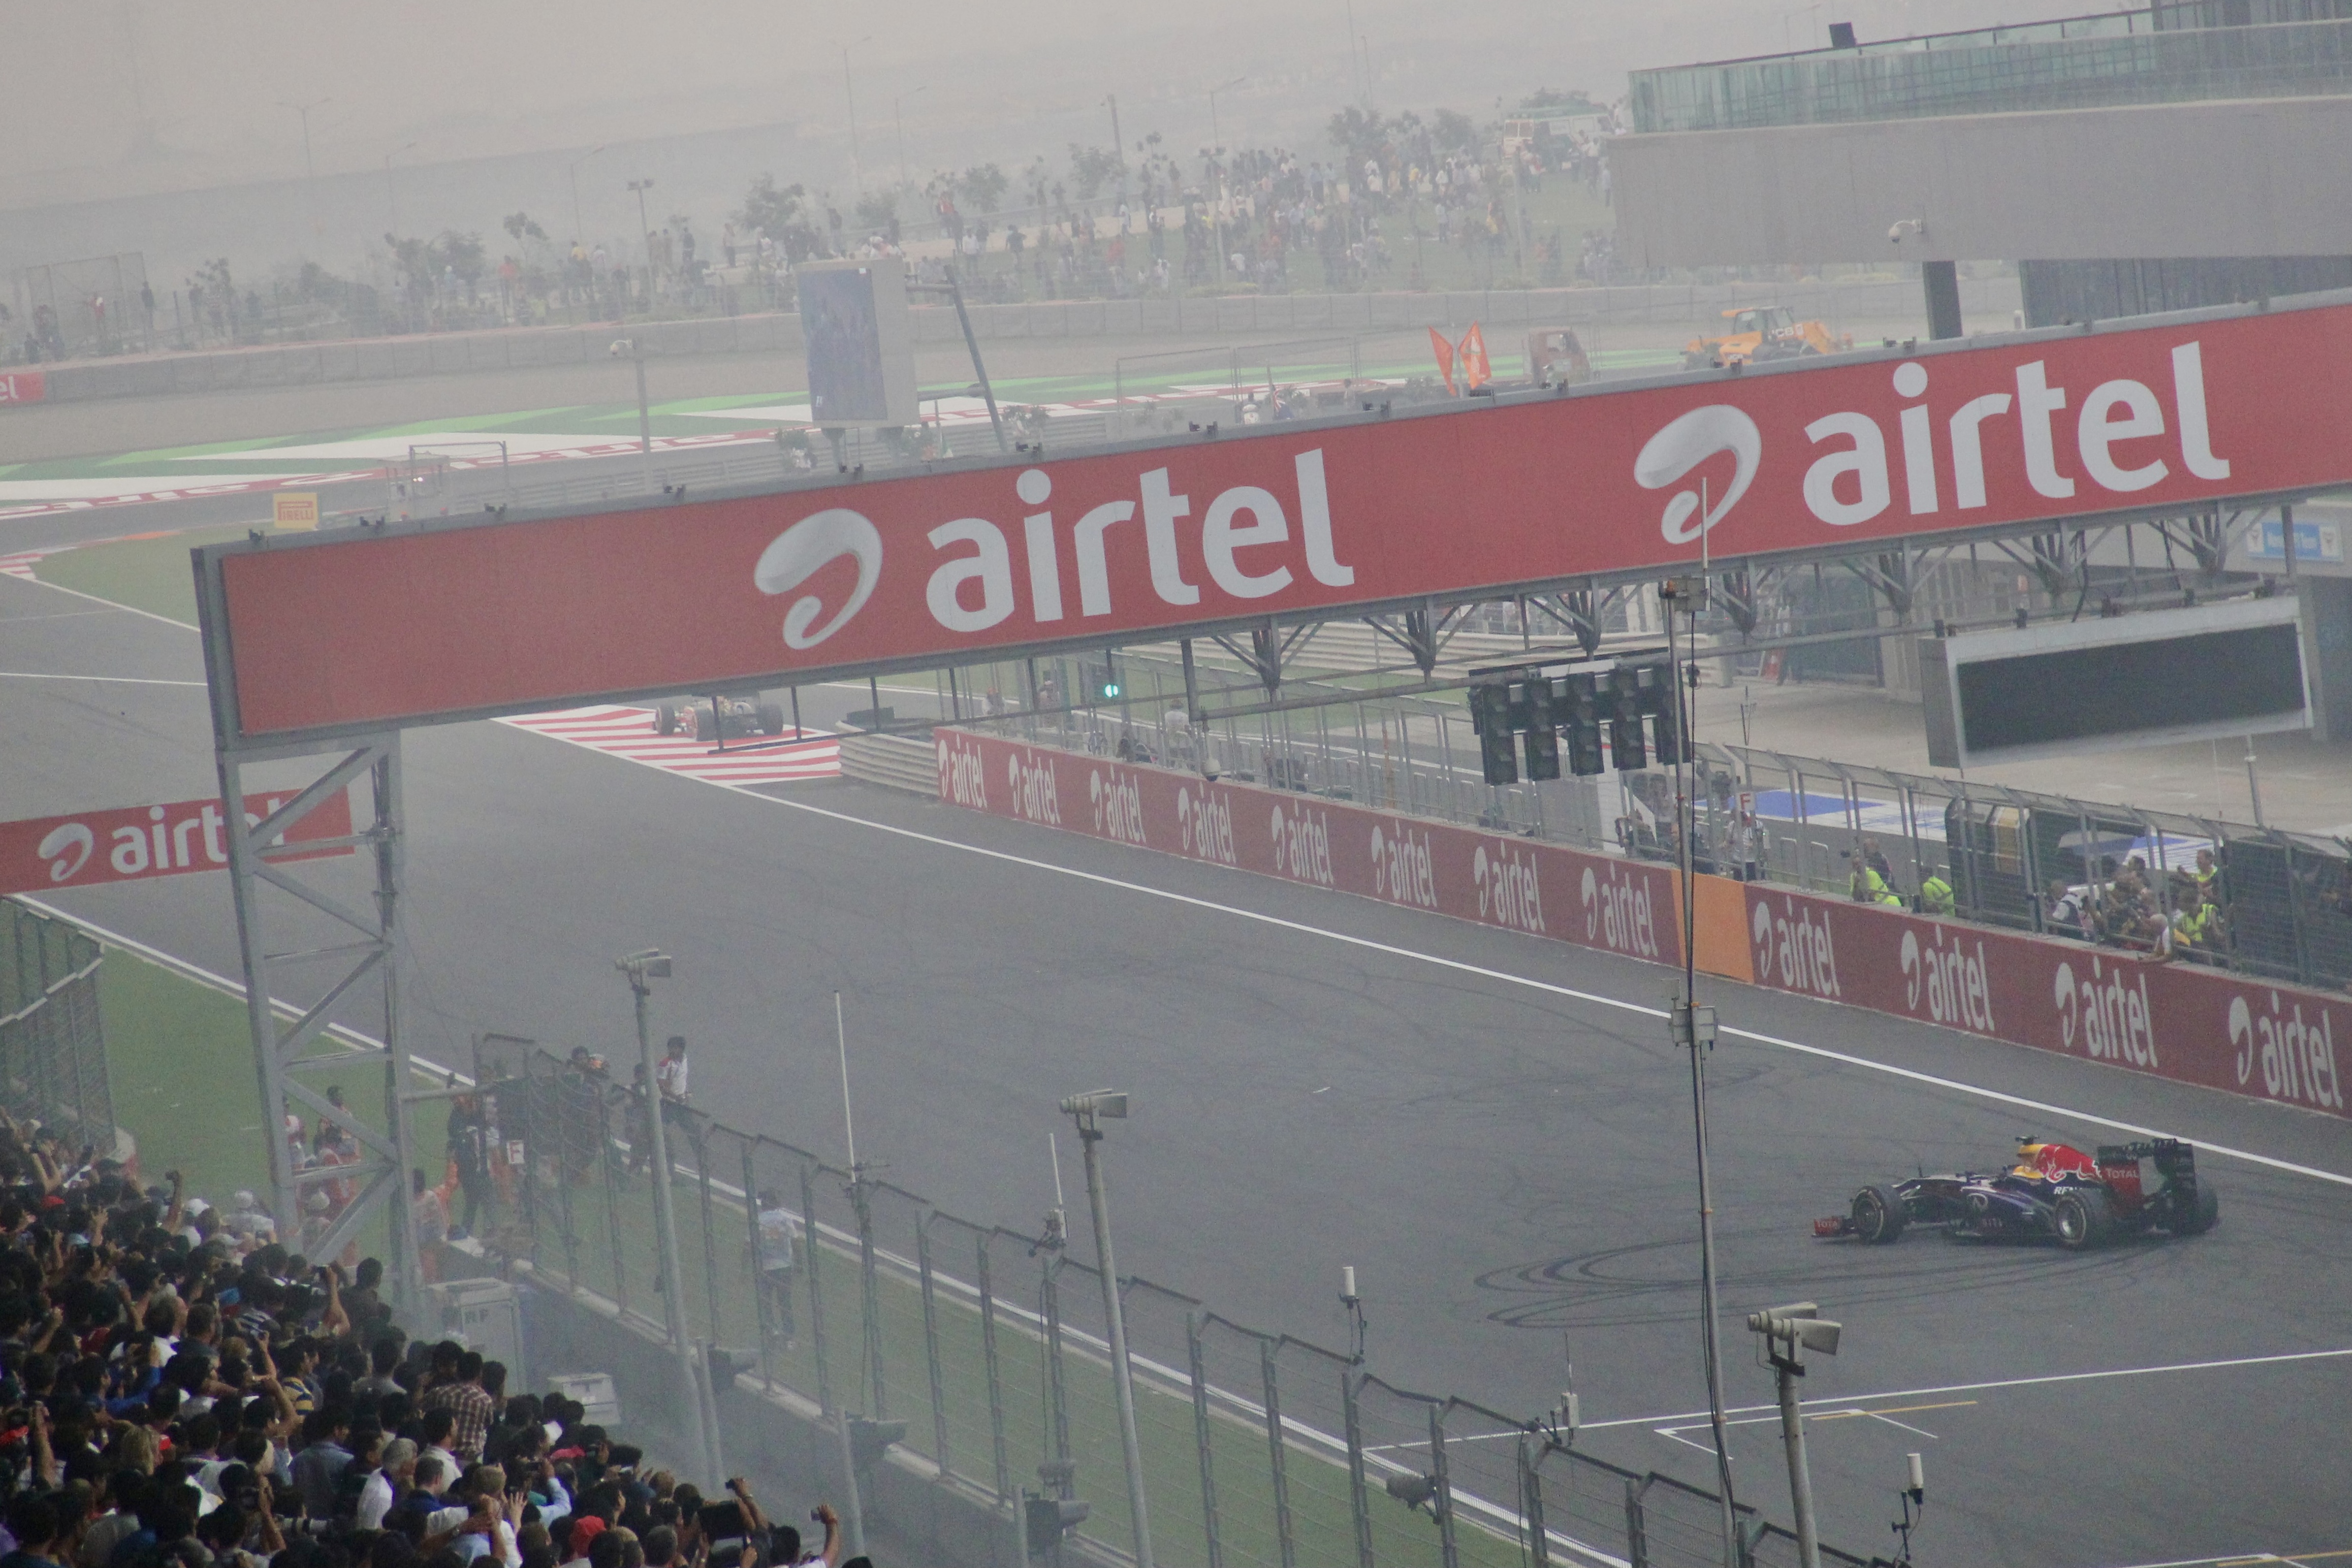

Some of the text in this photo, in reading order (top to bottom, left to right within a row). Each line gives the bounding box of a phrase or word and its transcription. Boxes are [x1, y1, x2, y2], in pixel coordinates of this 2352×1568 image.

[1803, 341, 2231, 525] airtel
[277, 501, 313, 521] PIRELLI
[927, 449, 1354, 632] airtel
[951, 733, 987, 808] airtel
[1023, 748, 1061, 824] airtel
[1105, 764, 1146, 843] airtel
[1740, 793, 1751, 810] F
[111, 798, 285, 874] airtl
[1194, 783, 1235, 863] airtel
[1288, 801, 1333, 883] airtel
[1388, 821, 1437, 906] airtel
[1493, 841, 1545, 932] airtel
[1601, 862, 1659, 957] airtel
[1777, 896, 1841, 996] airtel
[1925, 925, 1995, 1031] airtel
[2083, 956, 2158, 1068] airtel
[2259, 990, 2344, 1109] airtel
[510, 1142, 520, 1162] F
[2106, 1168, 2140, 1178] TOTAL
